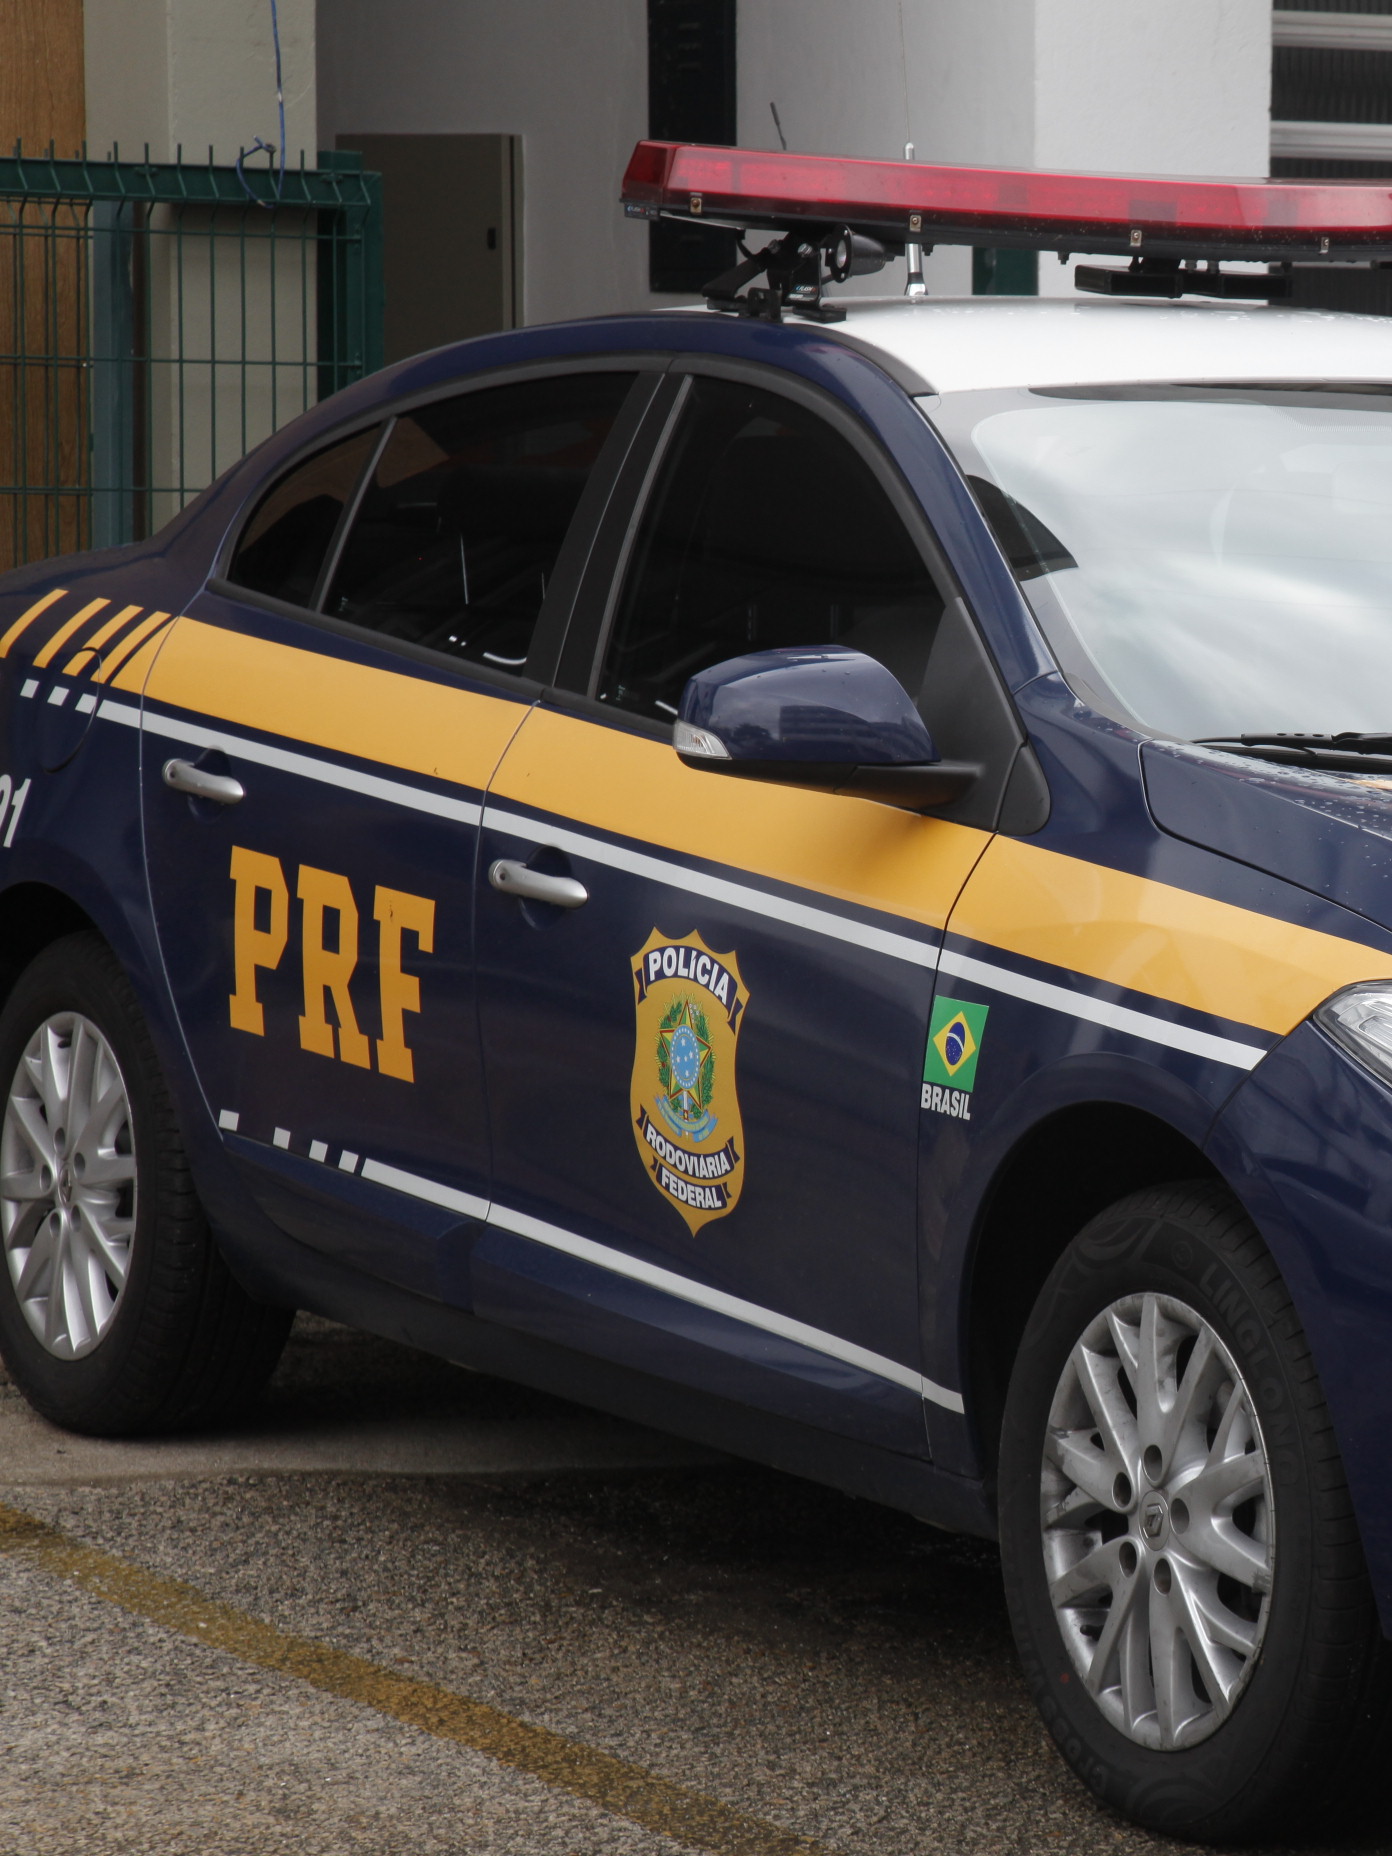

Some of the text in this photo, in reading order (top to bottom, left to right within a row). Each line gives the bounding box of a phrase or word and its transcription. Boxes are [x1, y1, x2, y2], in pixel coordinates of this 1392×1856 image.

[229, 845, 436, 1083] PRF
[648, 947, 730, 1005] POLÍCIA
[921, 1083, 971, 1121] BRASIL
[660, 1166, 723, 1210] FEDERAL
